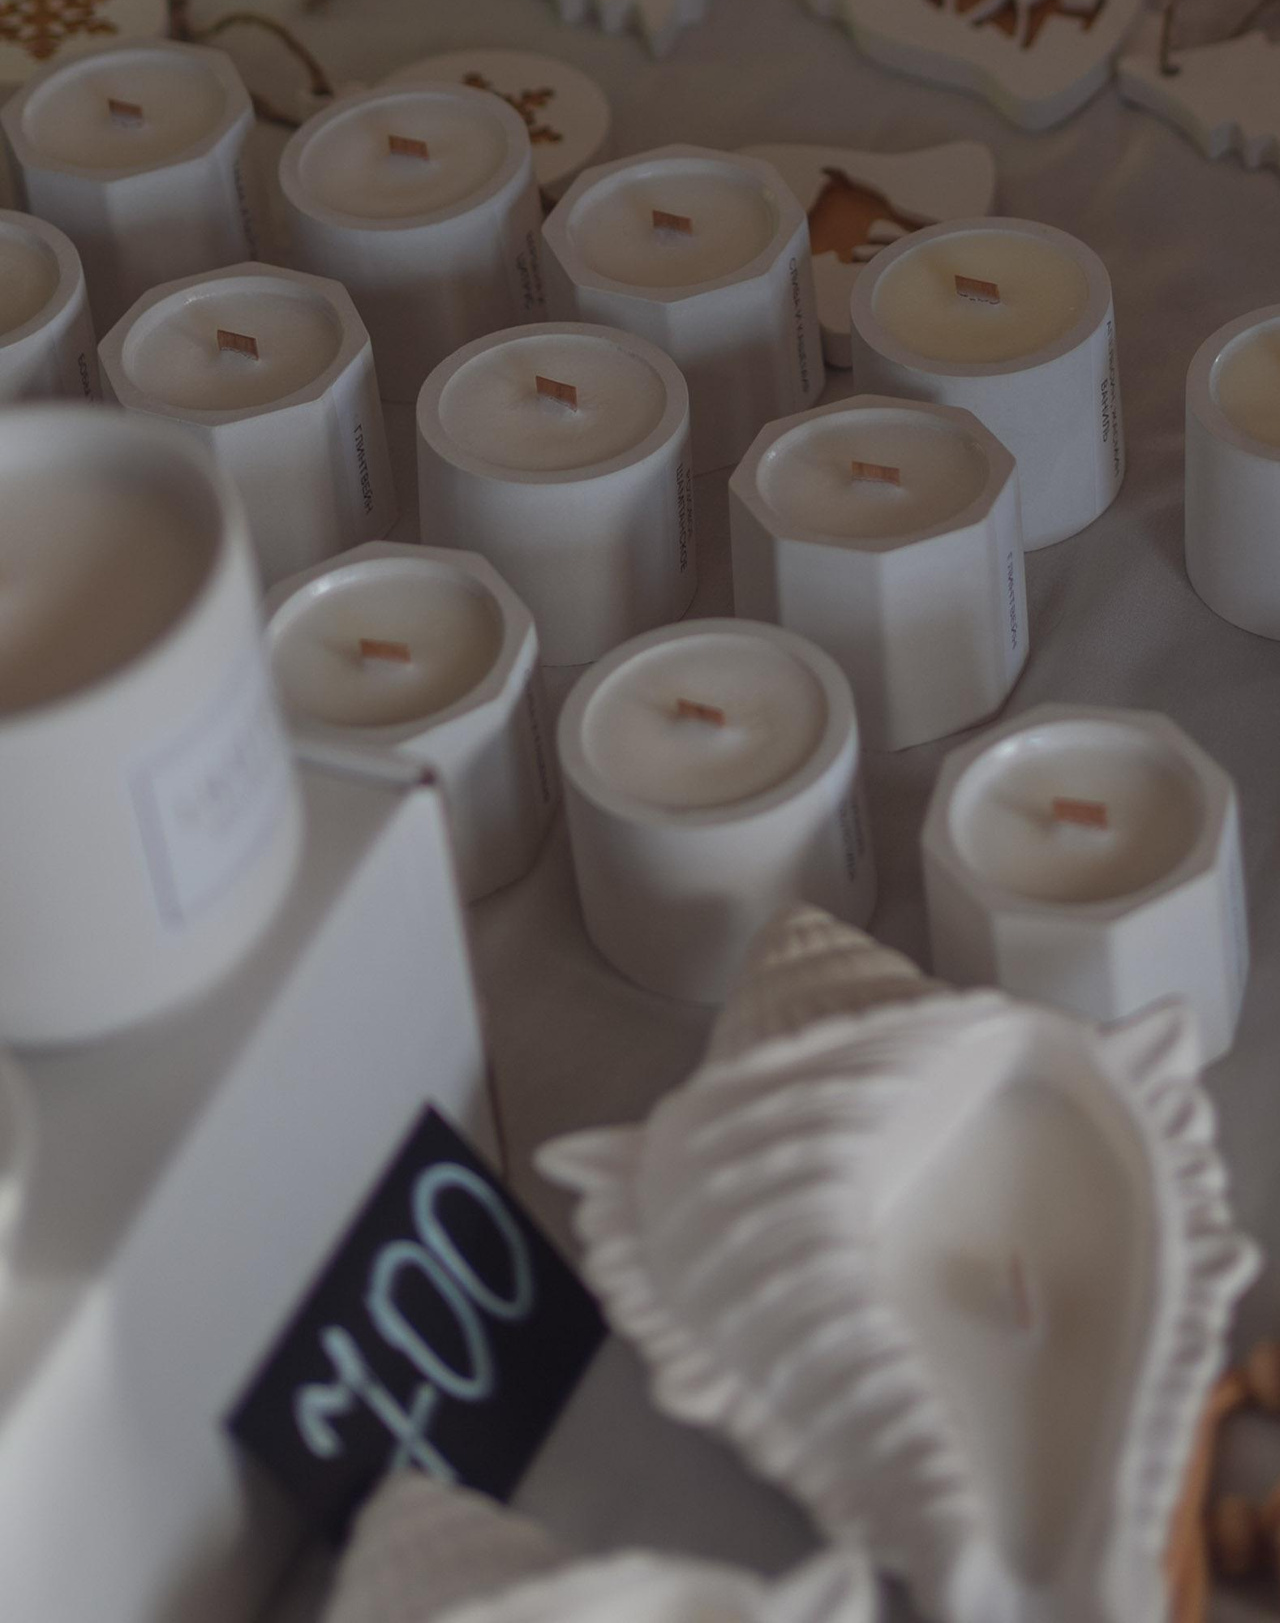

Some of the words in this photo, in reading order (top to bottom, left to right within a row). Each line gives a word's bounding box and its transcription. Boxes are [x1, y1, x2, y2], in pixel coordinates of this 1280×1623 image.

[1101, 378, 1110, 444] ВАНИЛЬ
[354, 424, 373, 515] ГЛИНТВЕЙН
[677, 462, 687, 574] ШАМПАНСКОЕ
[295, 1161, 534, 1482] 700
